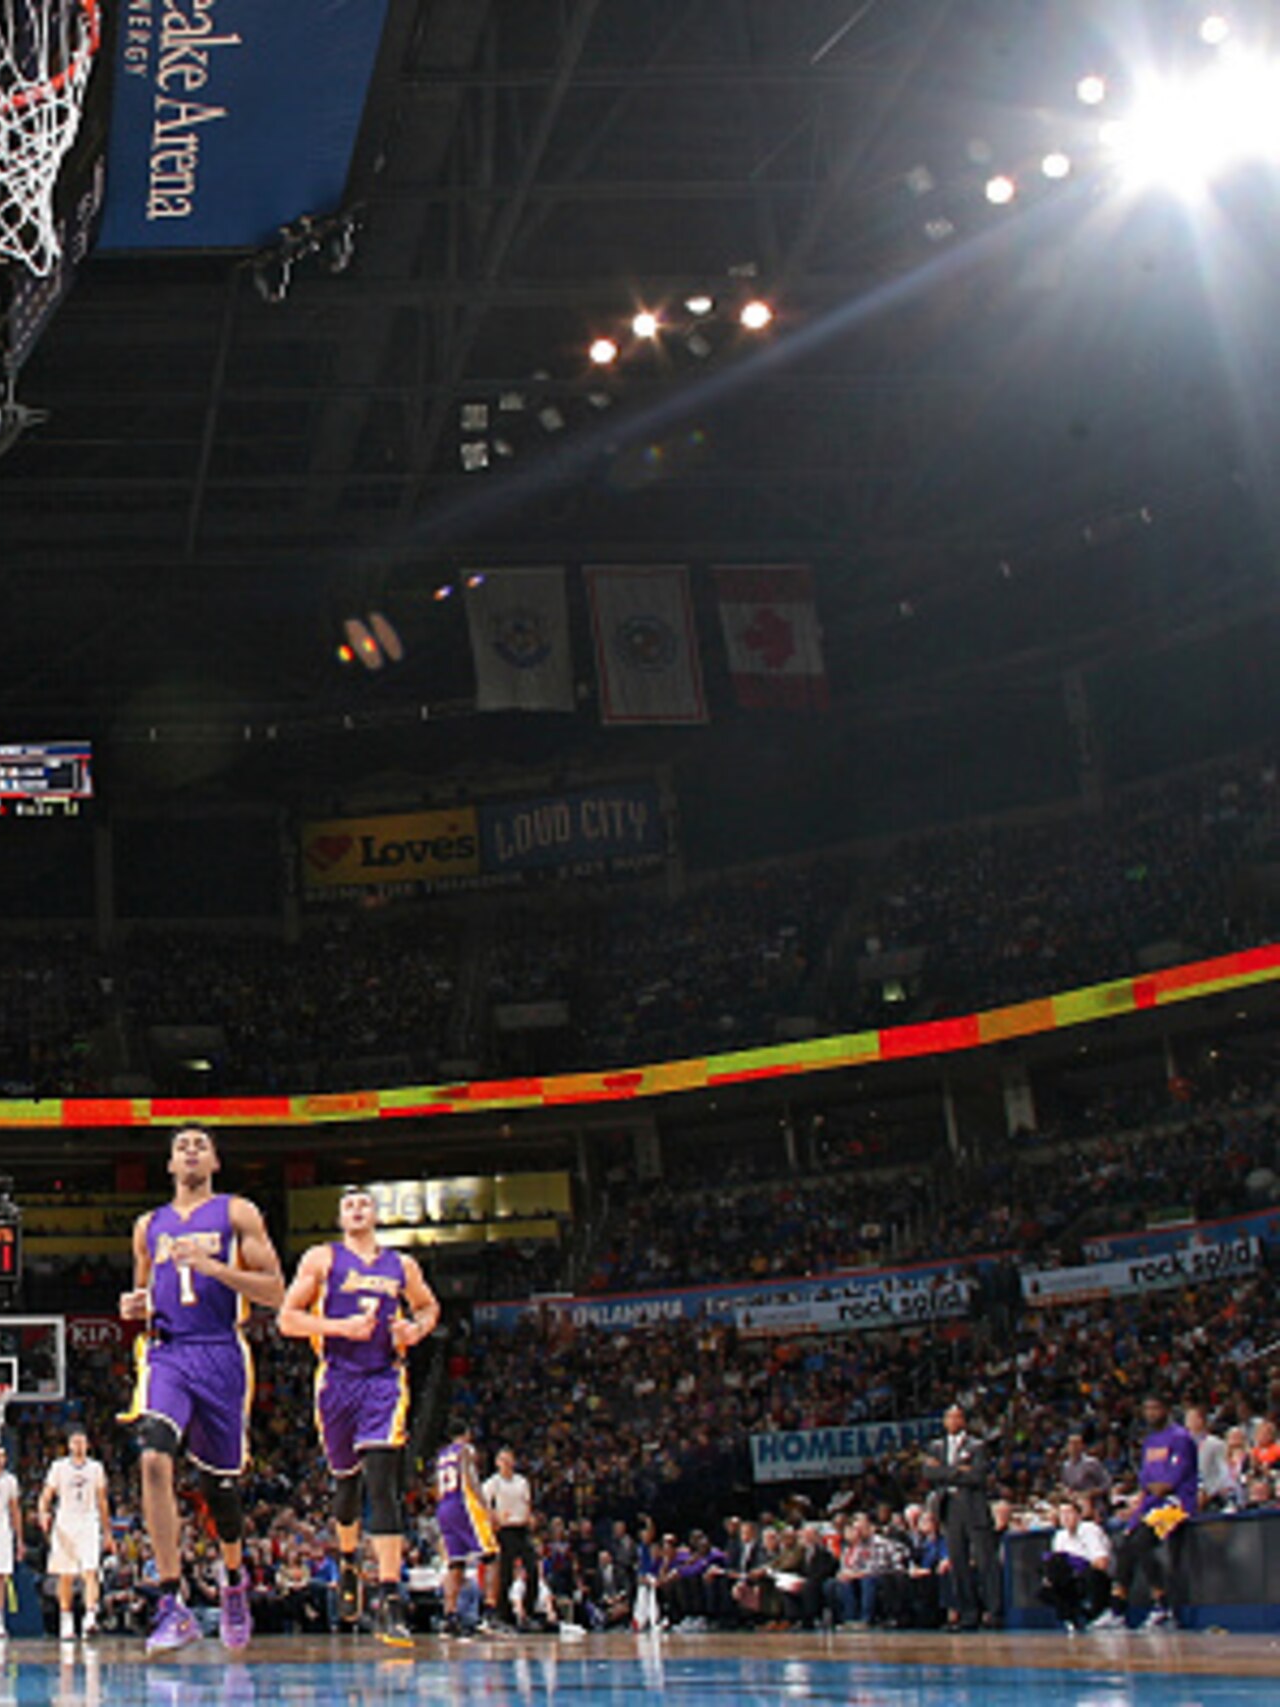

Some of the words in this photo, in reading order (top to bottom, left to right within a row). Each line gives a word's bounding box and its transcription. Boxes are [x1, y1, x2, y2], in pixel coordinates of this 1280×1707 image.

[146, 95, 229, 220] Arena
[495, 804, 571, 862] LOUD
[580, 799, 648, 843] CITY
[177, 1264, 197, 1306] 1
[1129, 1252, 1187, 1283] rock
